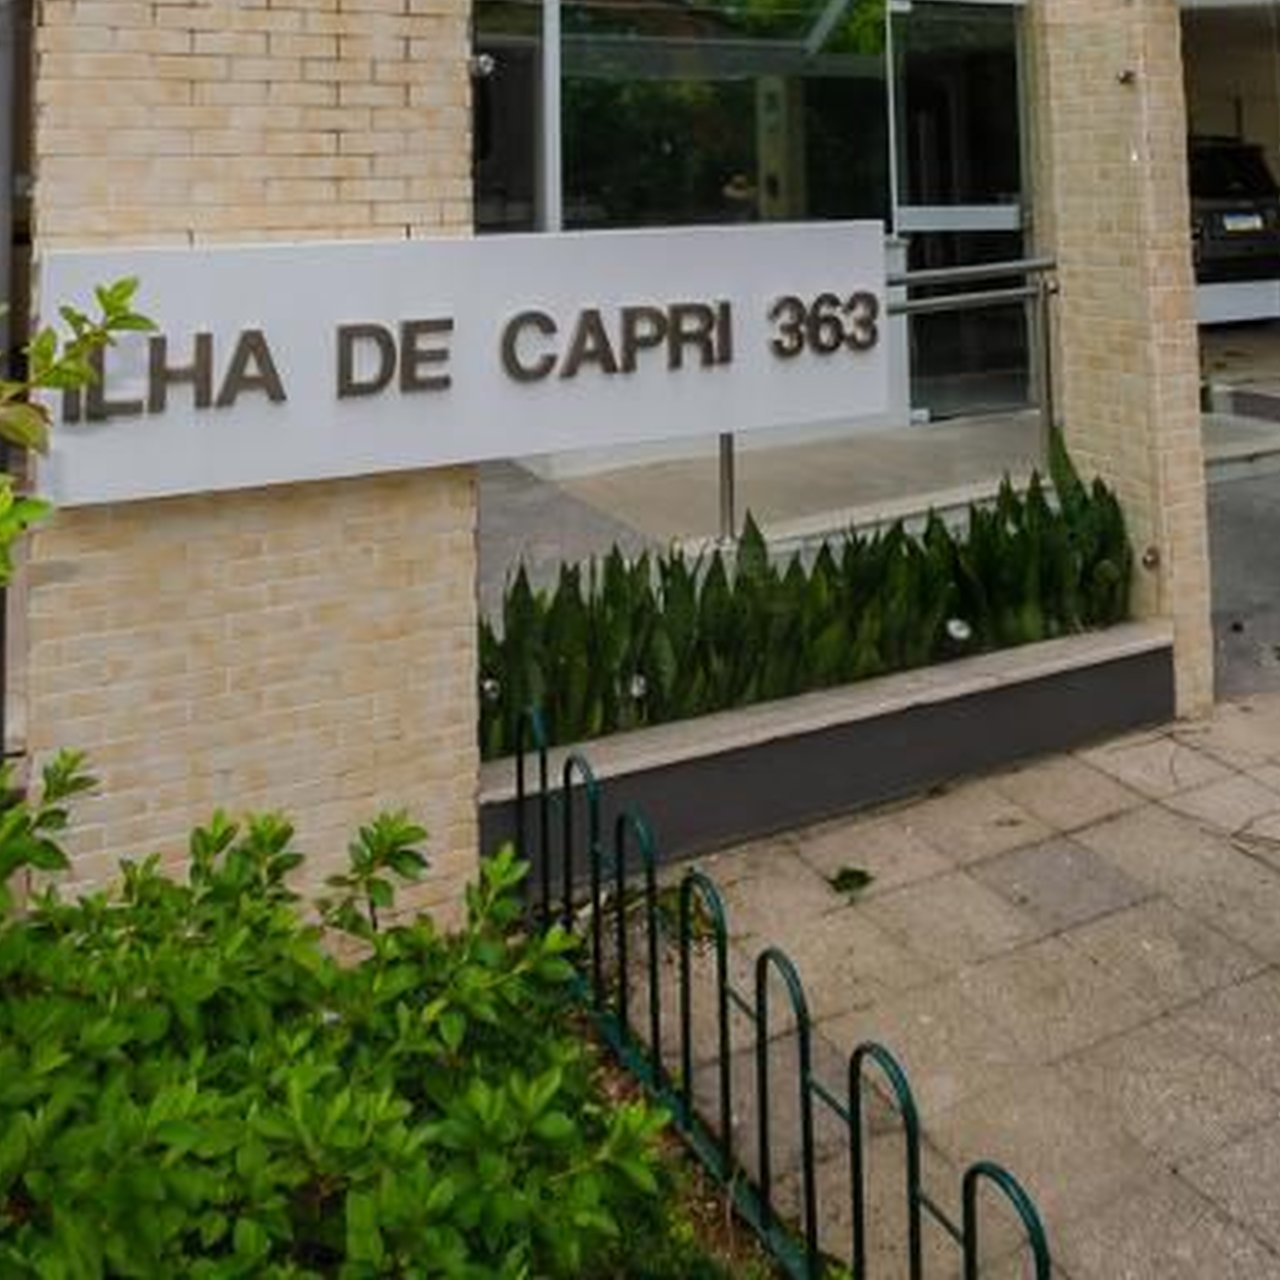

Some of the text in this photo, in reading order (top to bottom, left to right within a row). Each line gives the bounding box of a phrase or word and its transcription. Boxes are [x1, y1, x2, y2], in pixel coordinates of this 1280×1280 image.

[336, 319, 454, 398] DE
[500, 301, 731, 383] CAPRI
[770, 291, 879, 360] 363
